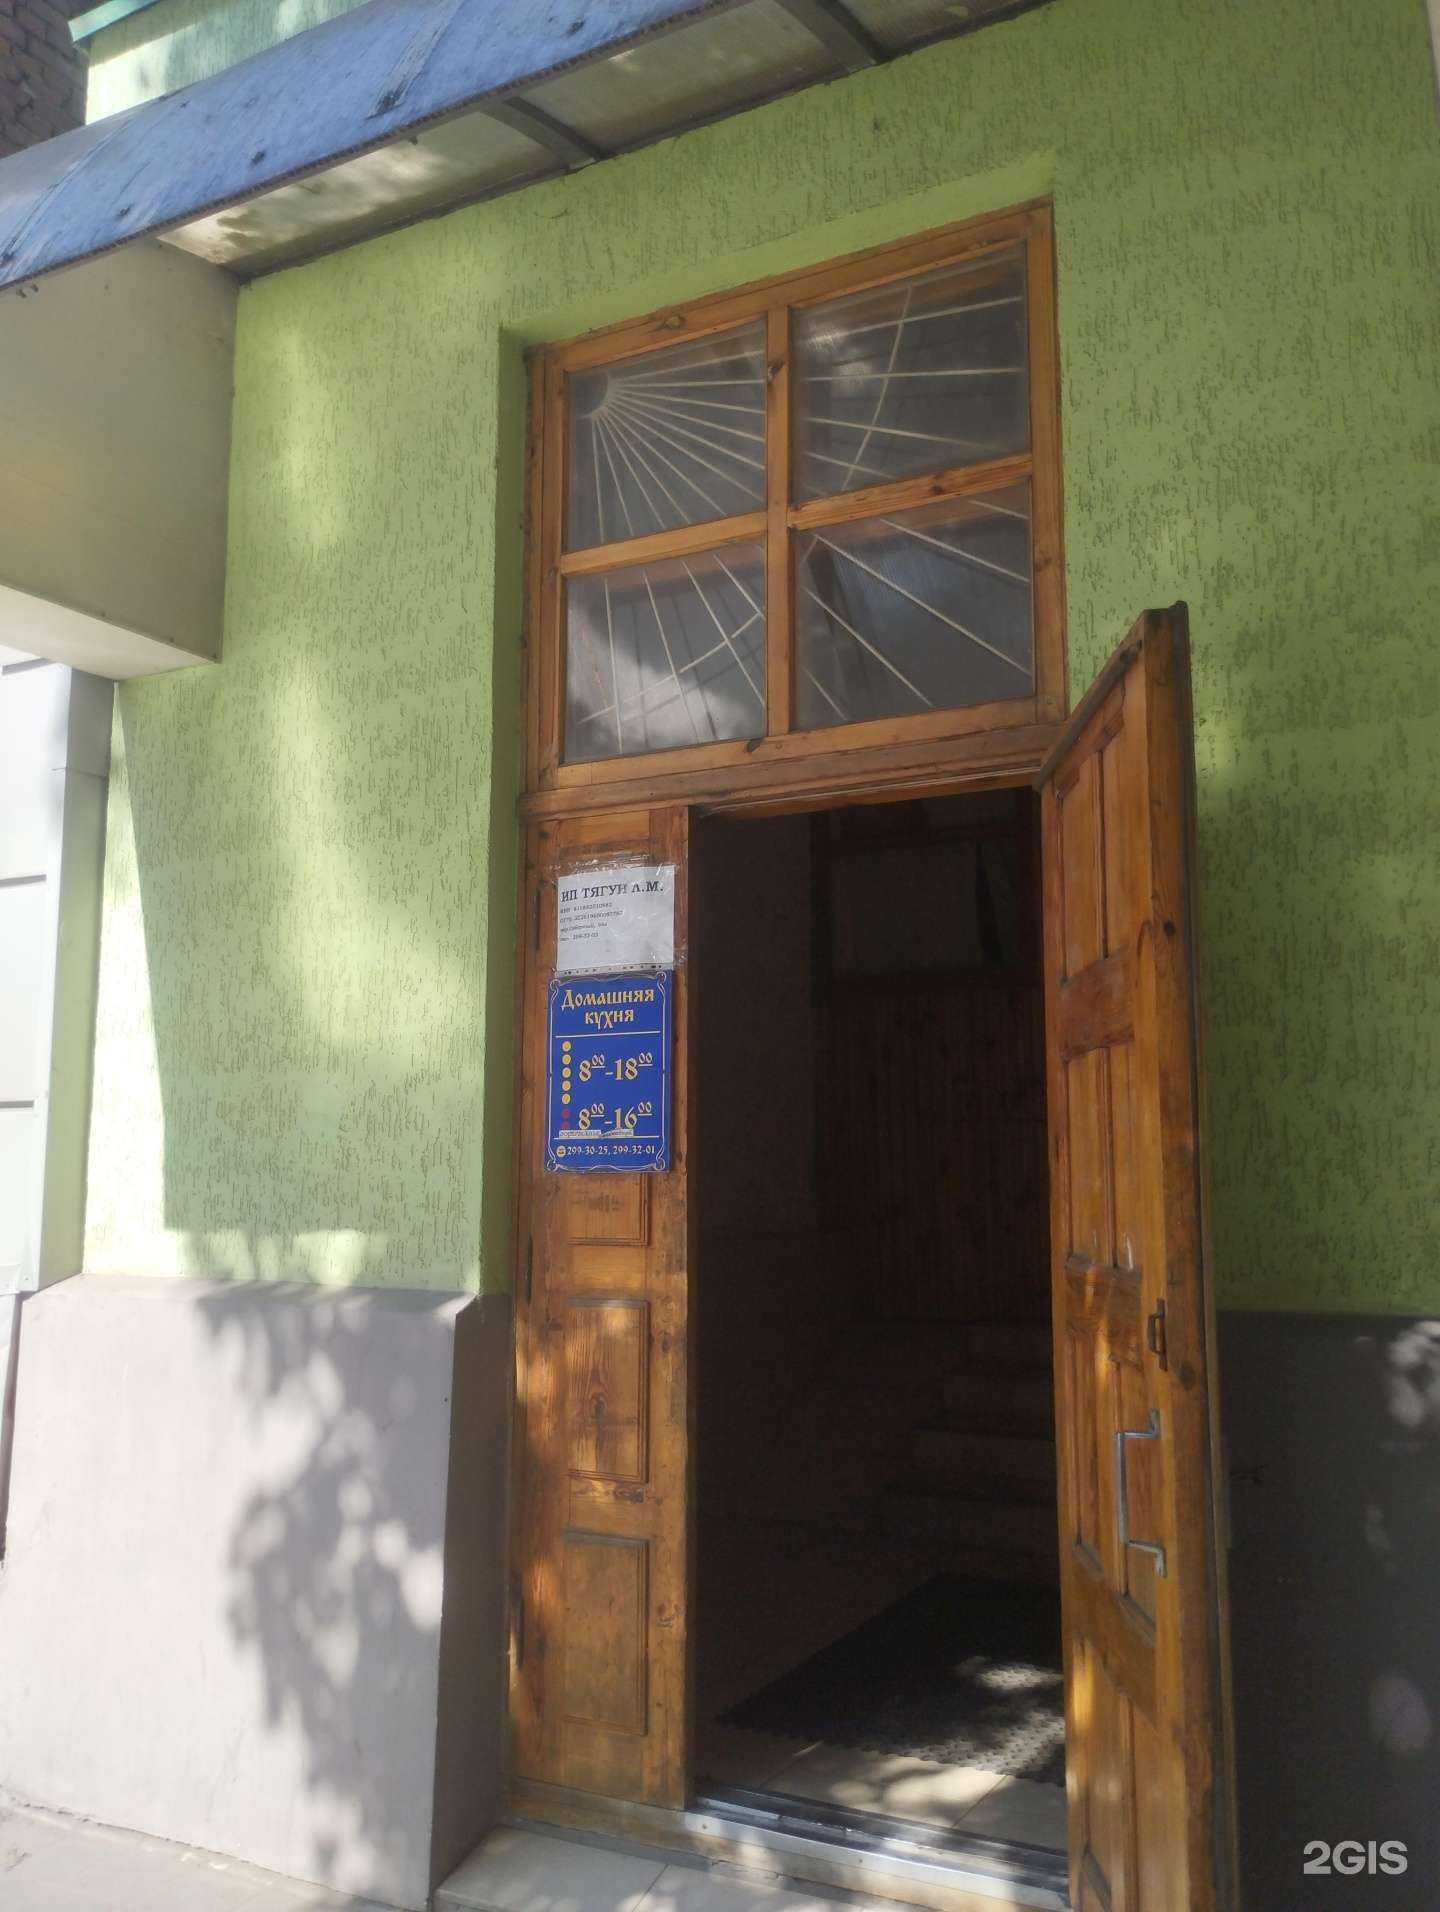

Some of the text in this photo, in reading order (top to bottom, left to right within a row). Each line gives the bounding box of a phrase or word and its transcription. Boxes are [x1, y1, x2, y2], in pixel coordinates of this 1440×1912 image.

[561, 889, 578, 903] ИП
[581, 883, 628, 899] ТЯГУН
[561, 989, 655, 1010] Домашняя
[585, 1009, 634, 1029] кухня
